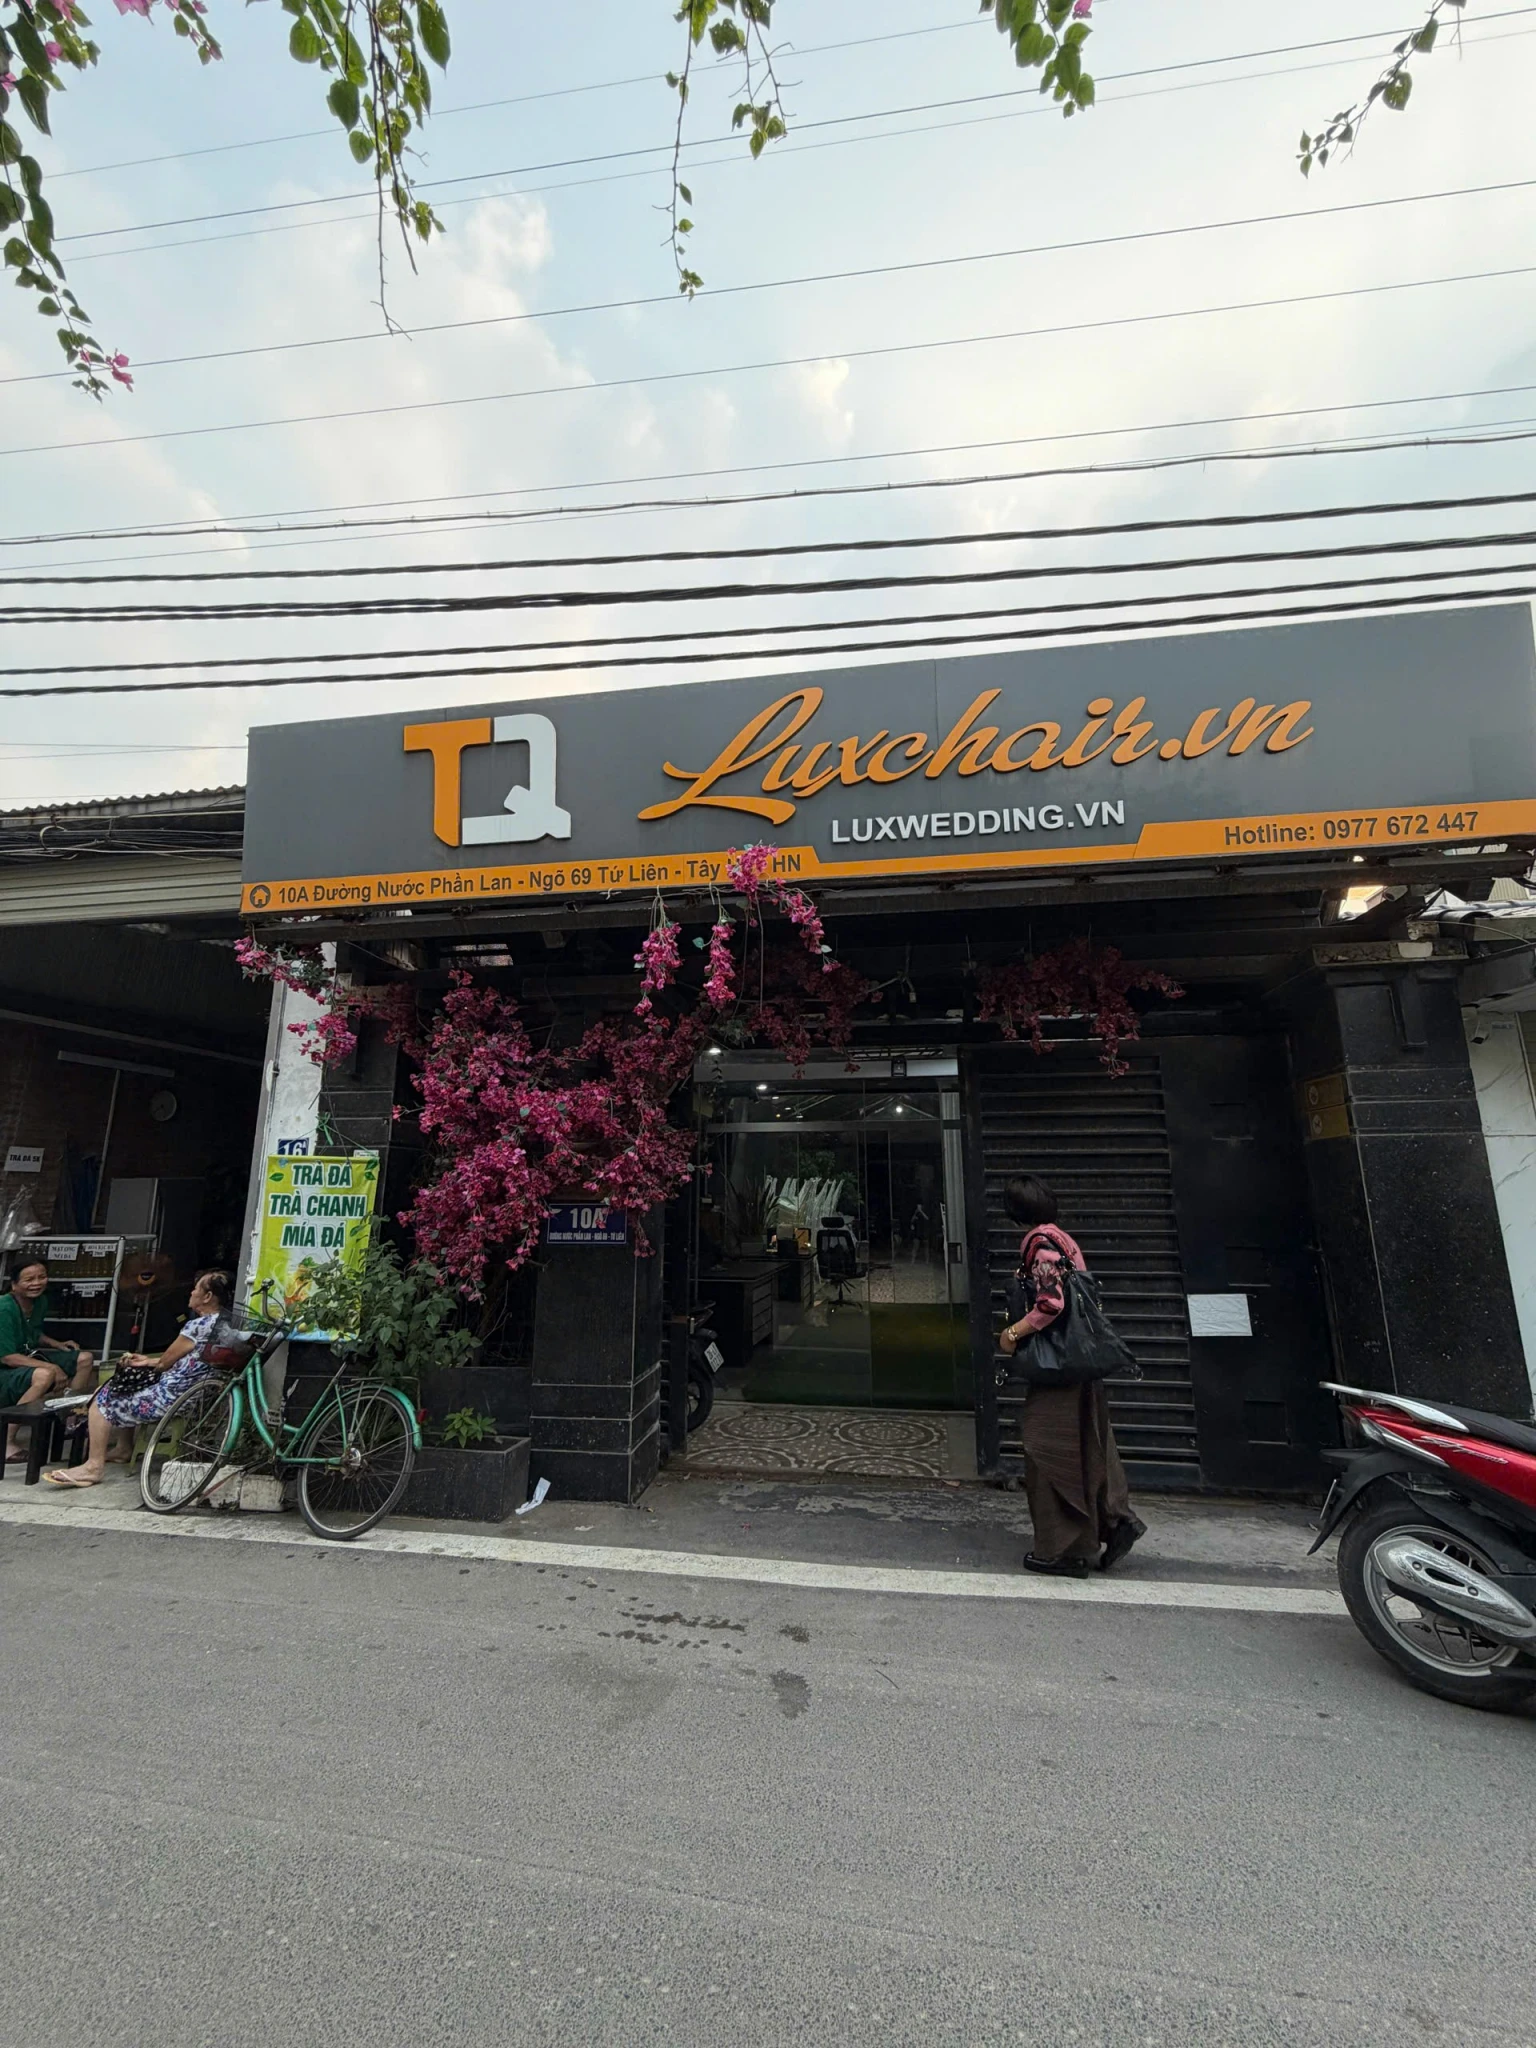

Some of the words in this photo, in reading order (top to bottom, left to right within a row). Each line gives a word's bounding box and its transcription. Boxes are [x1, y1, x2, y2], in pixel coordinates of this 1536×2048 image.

[637, 687, 1314, 825] Luxchair.vn
[831, 800, 1126, 844] LUXWEDDING.VN
[1224, 823, 1315, 846] Hotline:
[1323, 817, 1378, 840] 0977
[1386, 814, 1429, 836] 672
[1436, 811, 1479, 832] 447
[279, 886, 309, 904] 10A
[313, 883, 372, 903] Đường
[377, 878, 425, 898] Nước
[430, 872, 474, 895] Phần
[480, 875, 512, 891] Lan
[529, 868, 565, 891] Ngõ
[570, 867, 592, 885] 69
[598, 866, 625, 884] Tứ
[629, 862, 669, 882] Liên
[686, 859, 721, 882] Tây
[772, 854, 801, 873] HN
[293, 1162, 323, 1186] TRÀ
[327, 1162, 351, 1186] ĐÁ
[270, 1190, 302, 1215] TRÀ
[306, 1195, 366, 1217] CHANH
[282, 1221, 316, 1247] MÍA
[320, 1222, 345, 1248] ĐÁ
